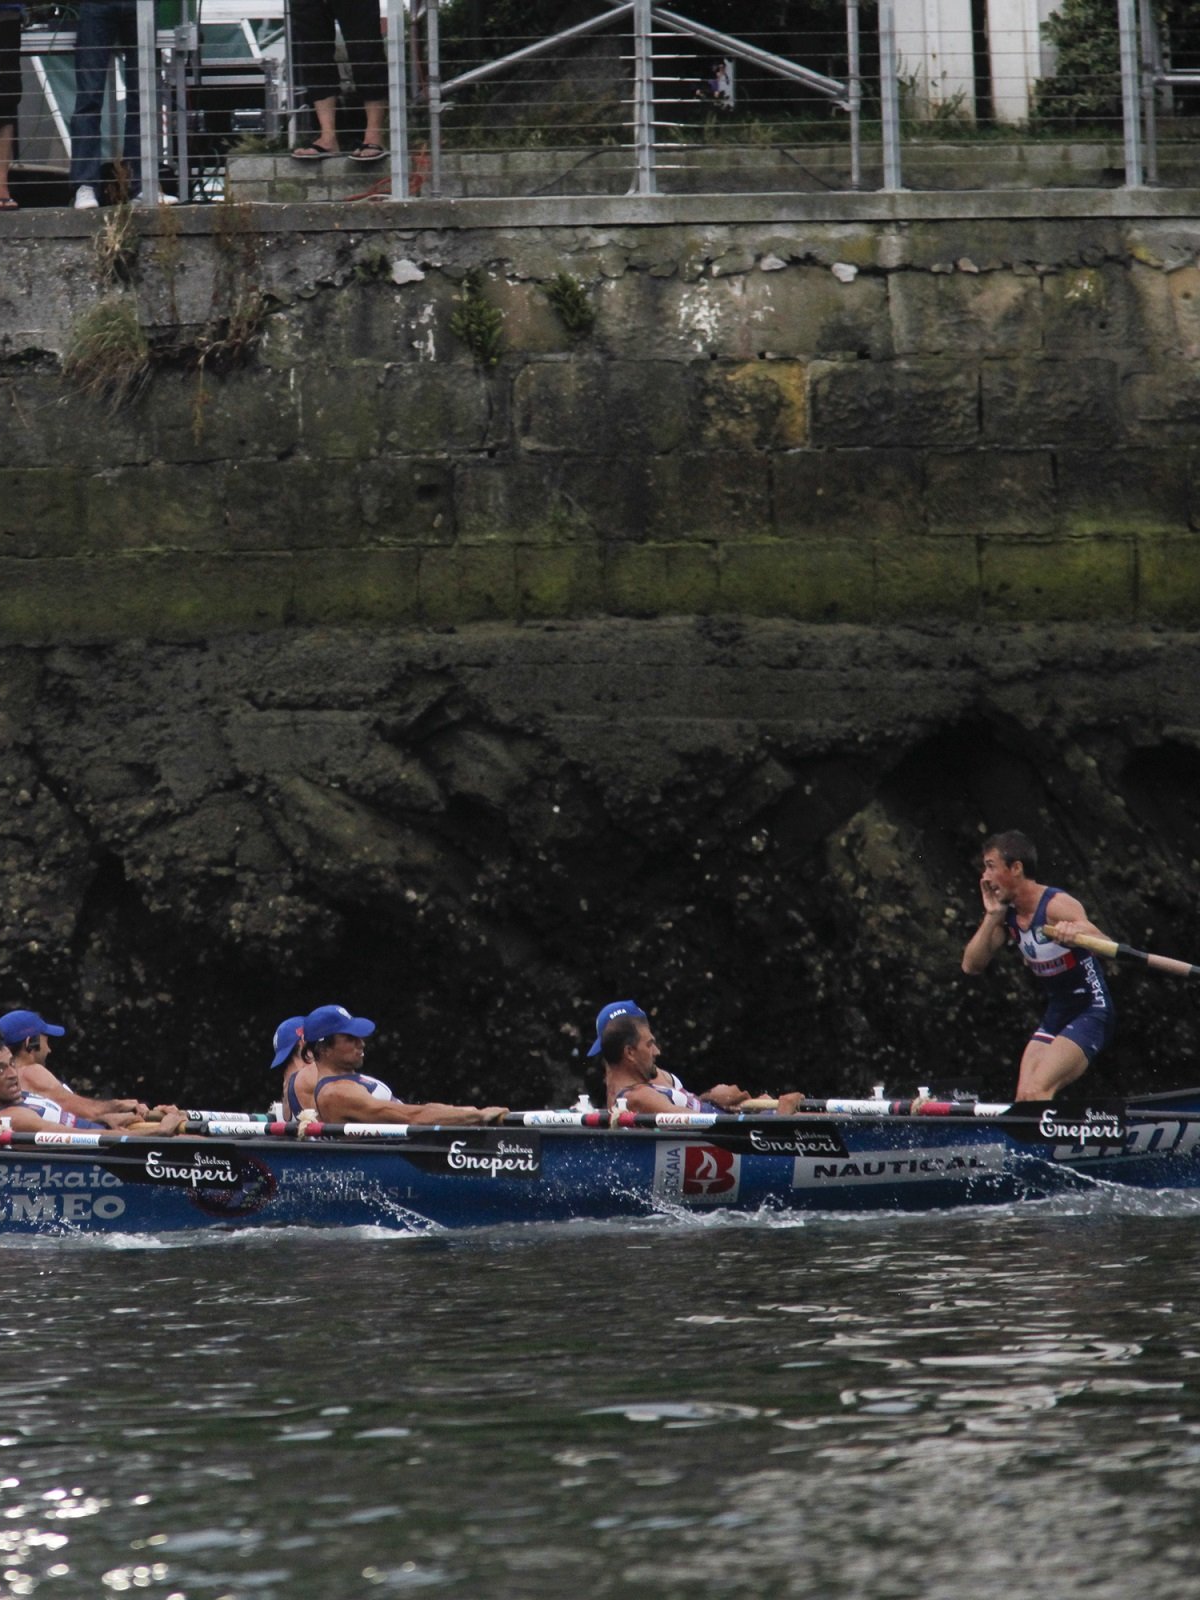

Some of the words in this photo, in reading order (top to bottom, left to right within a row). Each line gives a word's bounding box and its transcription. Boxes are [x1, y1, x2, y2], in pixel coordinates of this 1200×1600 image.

[750, 1130, 841, 1157] Eneperi
[1039, 1109, 1123, 1145] Eneperi
[146, 1151, 238, 1187] Eneperi
[447, 1140, 539, 1177] Eneperi
[813, 1156, 986, 1179] NAUTICAL
